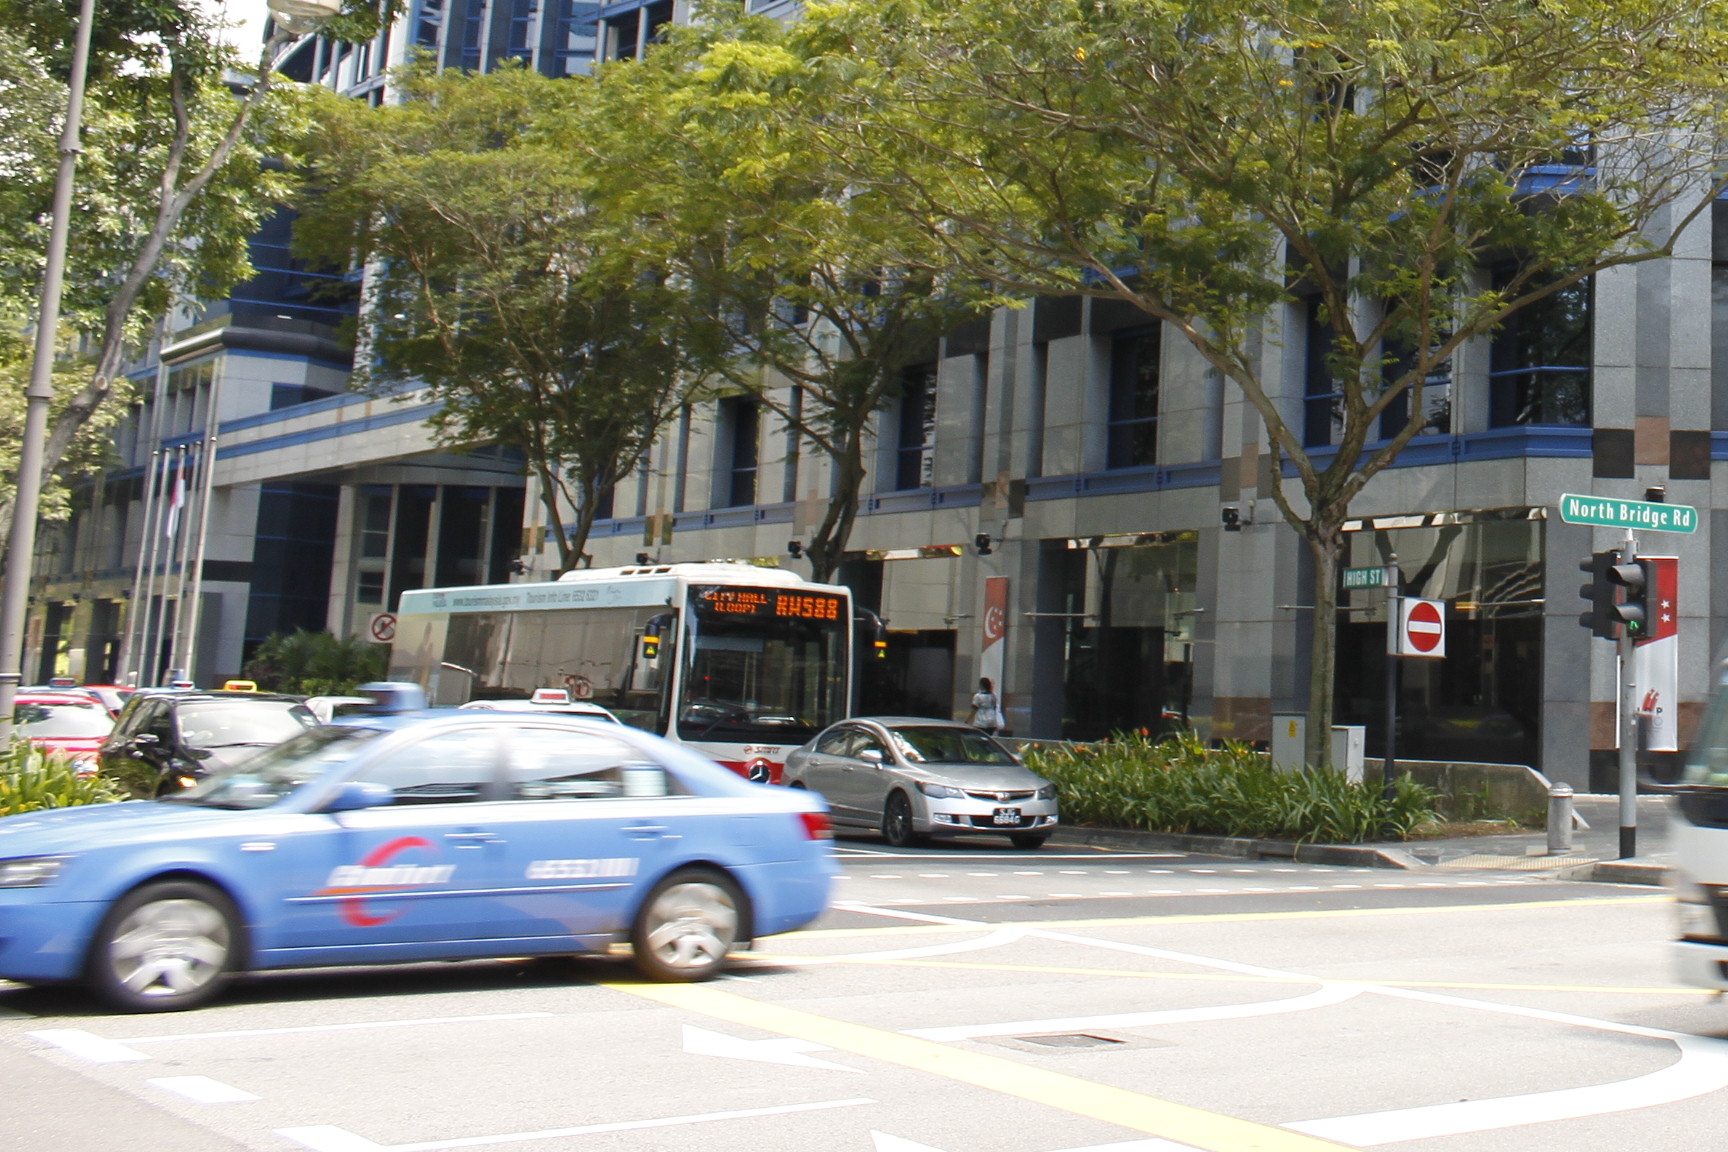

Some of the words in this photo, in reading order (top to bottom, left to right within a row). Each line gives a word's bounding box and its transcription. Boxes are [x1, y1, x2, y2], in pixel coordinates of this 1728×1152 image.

[1569, 498, 1614, 520] North
[1619, 503, 1668, 528] Bridge
[1673, 509, 1690, 527] Rd
[1346, 570, 1367, 586] HIGH
[1369, 568, 1381, 585] ST
[738, 592, 768, 605] HALL
